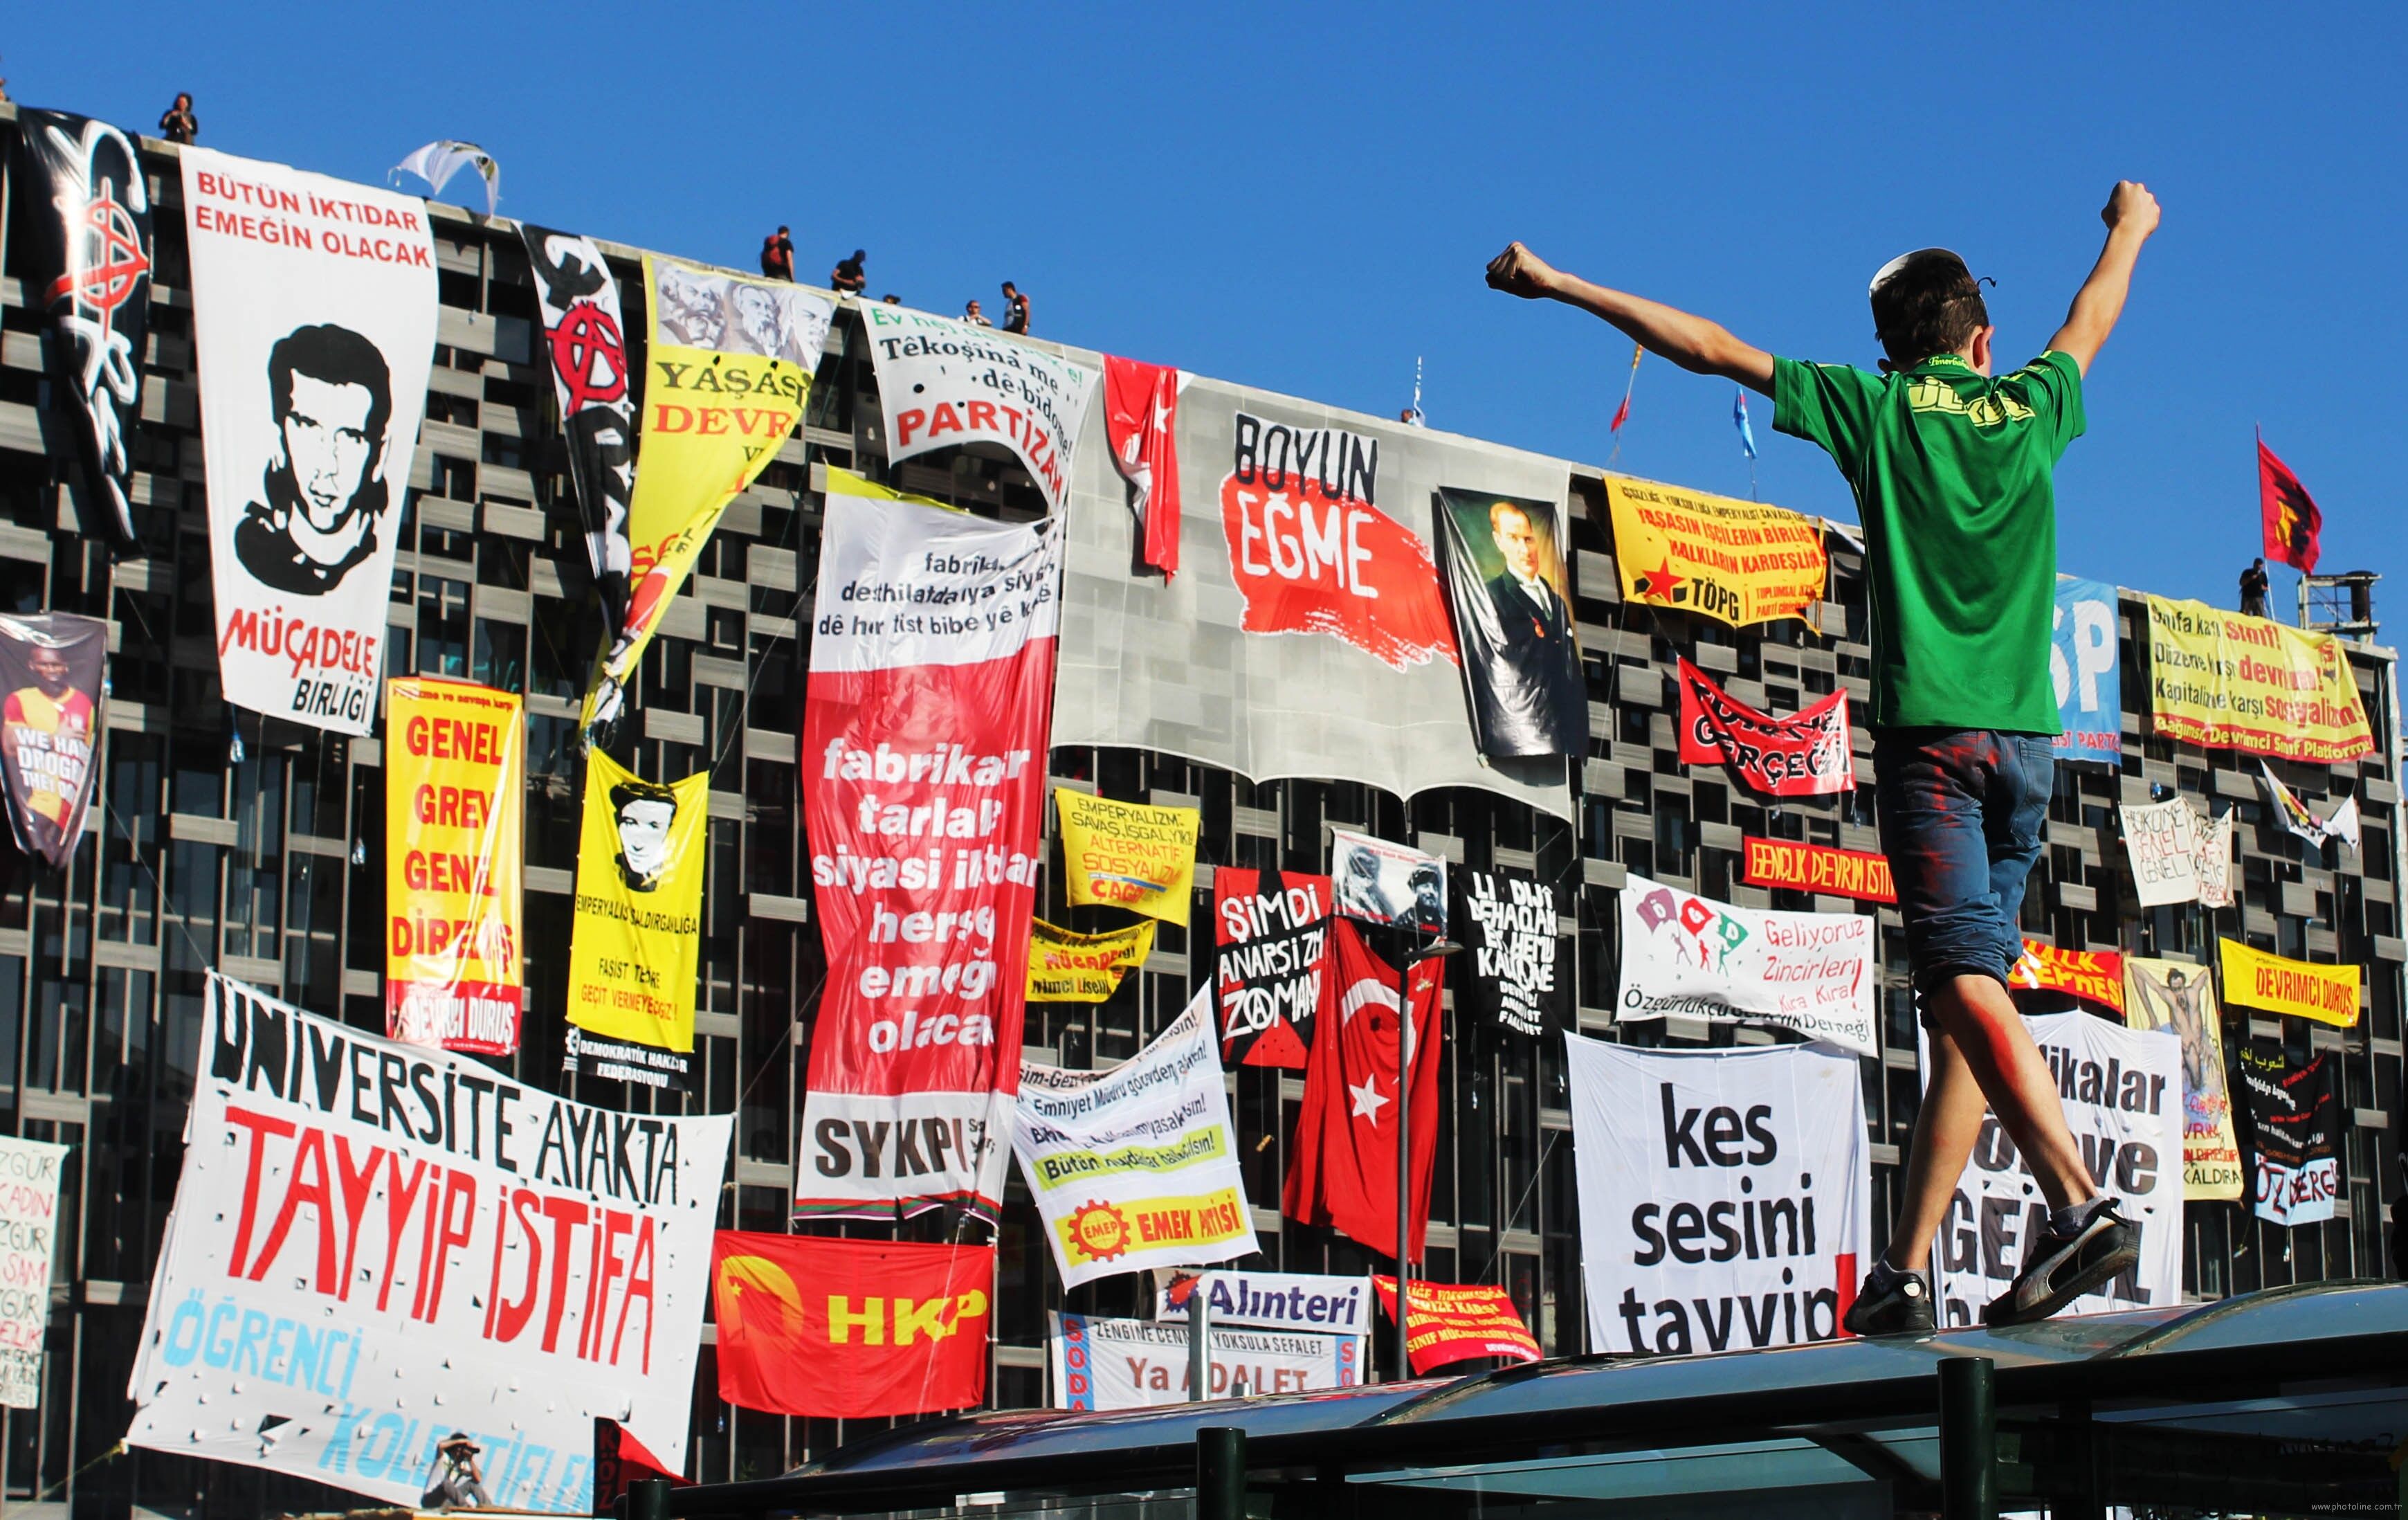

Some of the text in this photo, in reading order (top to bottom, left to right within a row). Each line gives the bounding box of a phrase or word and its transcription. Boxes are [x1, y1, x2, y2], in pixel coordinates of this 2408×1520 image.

[197, 171, 300, 214] BÜTÜN
[196, 206, 432, 269] EMEĞİN OLACAK
[983, 367, 1015, 393] dê
[1027, 360, 1059, 397] me
[896, 399, 1064, 507] PARTİZAN
[1235, 413, 1378, 505] BOYUN
[1237, 489, 1379, 599] EĞME
[819, 613, 844, 635] dê
[929, 615, 978, 636] bibe
[985, 605, 1013, 631] yê
[1691, 577, 1740, 622] TÖPG
[15, 729, 50, 751] WE
[406, 715, 504, 766] GENEL
[812, 843, 941, 896] siyasi
[1220, 883, 1322, 944] ŞİMDİ
[1764, 918, 1865, 951] Geliyoruz
[1763, 952, 1859, 981] Zincirleri
[814, 1116, 953, 1179] SYKP
[1659, 1082, 1778, 1168] kes
[536, 1101, 679, 1210] AYAKTA
[224, 1105, 656, 1377] TAYYİP İSTİFA
[1083, 1220, 1119, 1239] EMEP
[1135, 1209, 1194, 1243] EMEK
[1631, 1172, 1816, 1267] sesini
[827, 1288, 988, 1348] HKP
[1207, 1278, 1360, 1326] Alınteri
[161, 1287, 363, 1400] ÖĞRENCİ
[1096, 1318, 1153, 1342] ZENGİNE
[1212, 1332, 1271, 1352] YOKSULA
[1273, 1339, 1322, 1355] SEFALET
[1126, 1357, 1169, 1390] Ya
